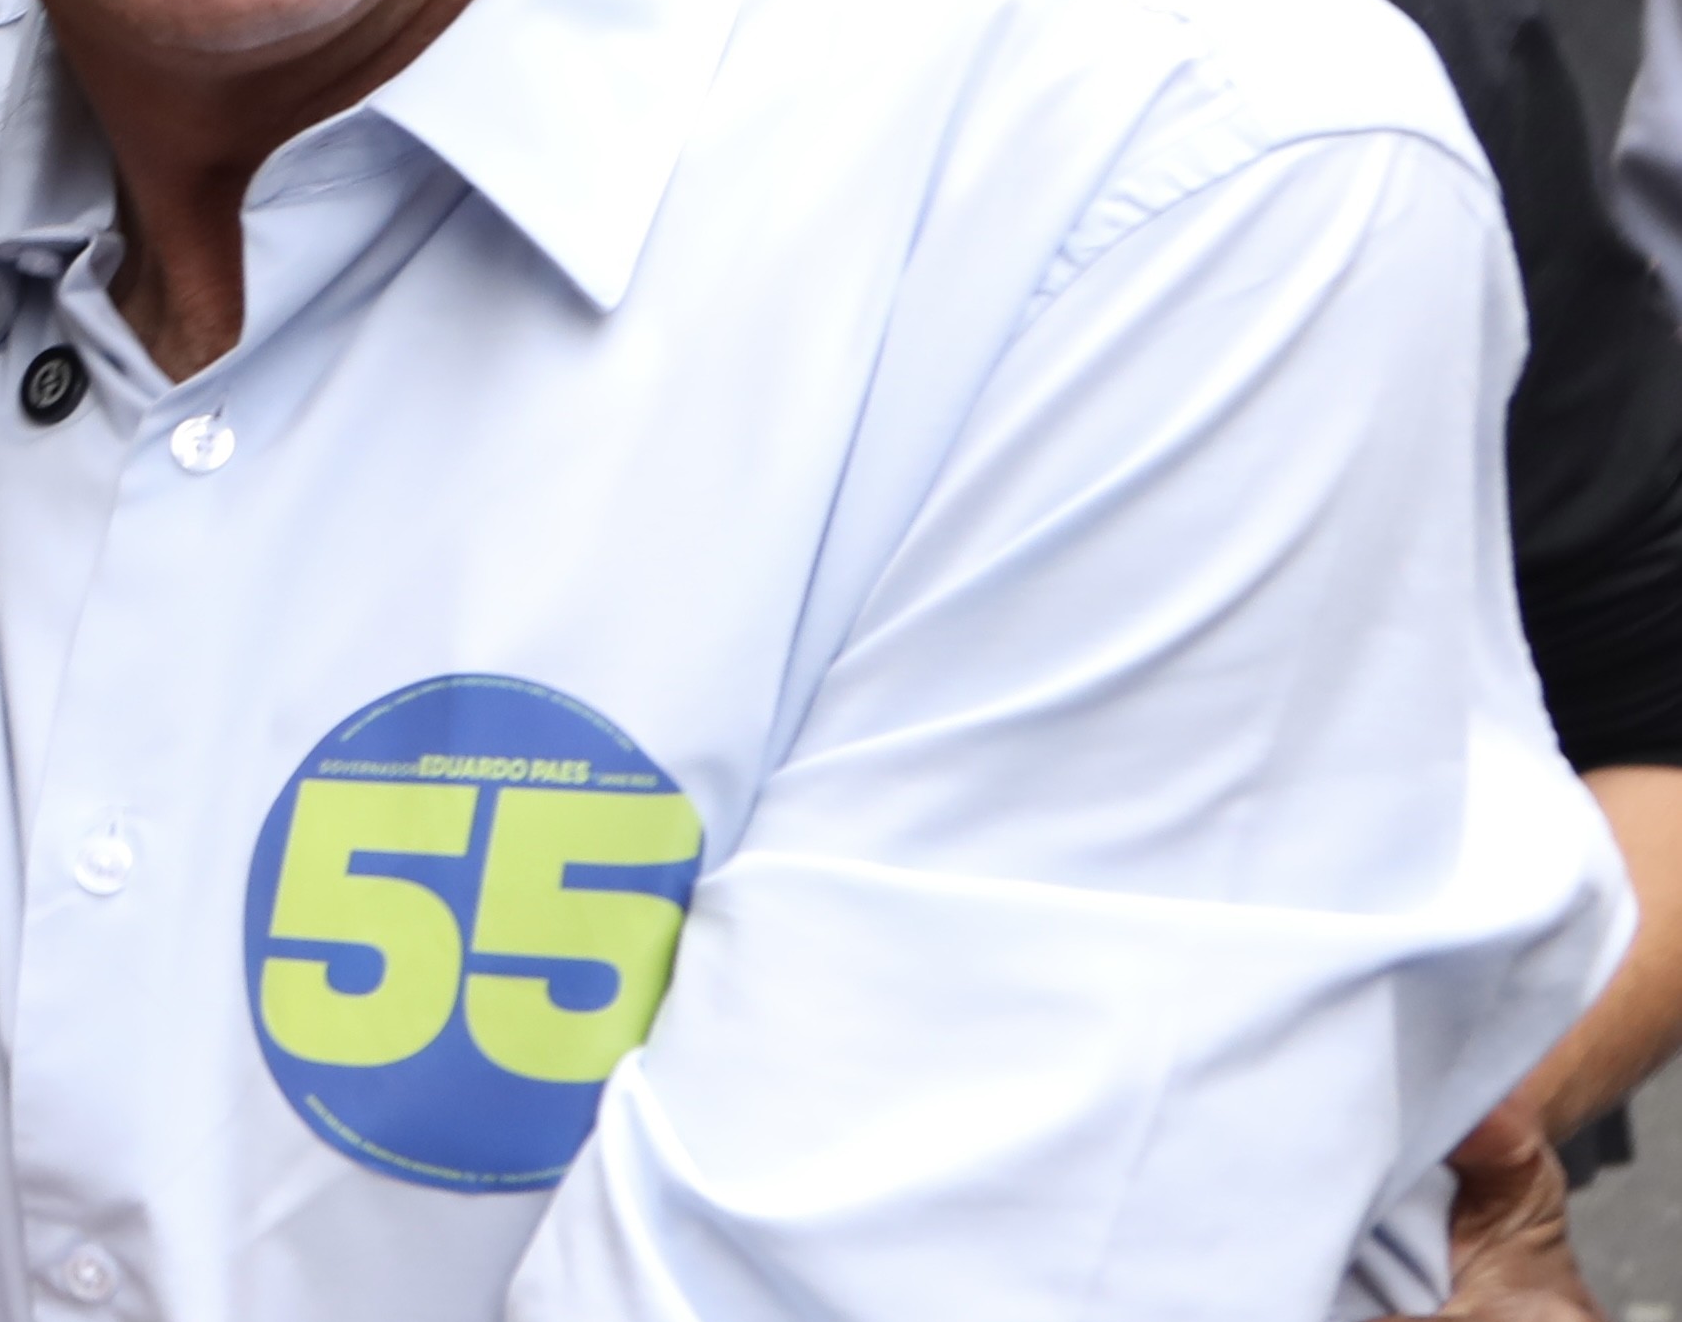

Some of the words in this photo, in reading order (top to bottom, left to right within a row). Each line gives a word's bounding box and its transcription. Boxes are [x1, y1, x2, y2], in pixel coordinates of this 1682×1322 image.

[418, 754, 527, 781] EDUARDO
[530, 758, 592, 785] PAES
[259, 778, 704, 1084] 55
